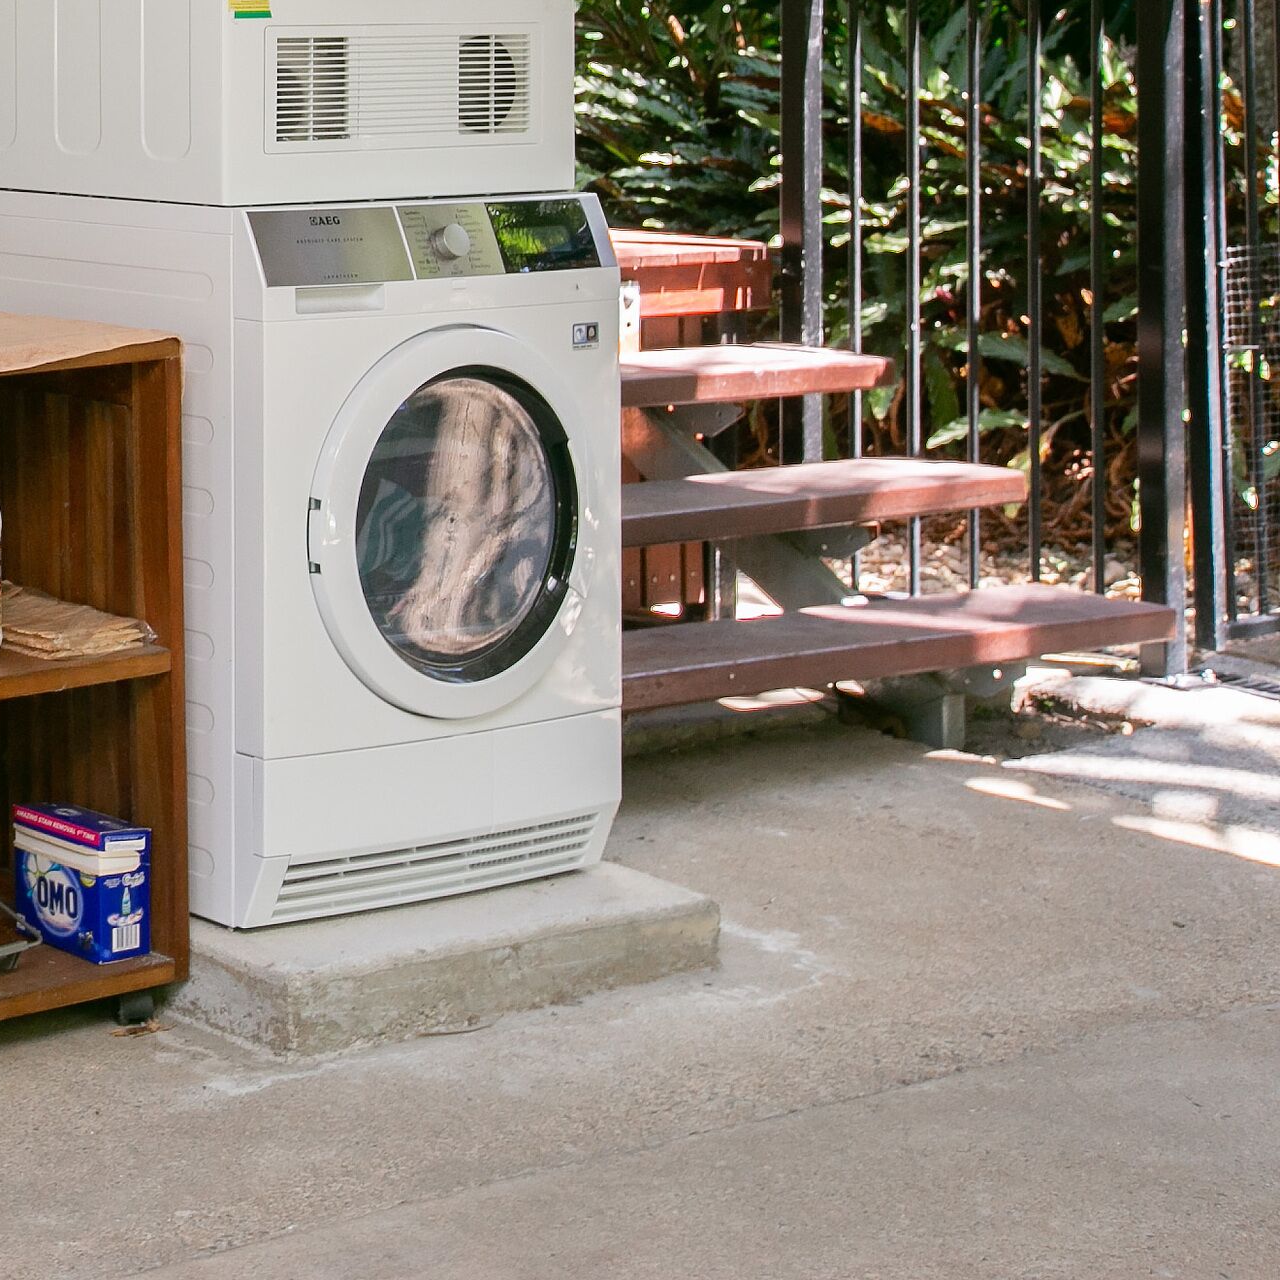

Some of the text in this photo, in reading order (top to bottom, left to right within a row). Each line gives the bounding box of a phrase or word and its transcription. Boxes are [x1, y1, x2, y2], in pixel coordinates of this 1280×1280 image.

[318, 215, 341, 226] AEG
[52, 821, 76, 836] REMOVAL
[37, 876, 78, 919] OMO
